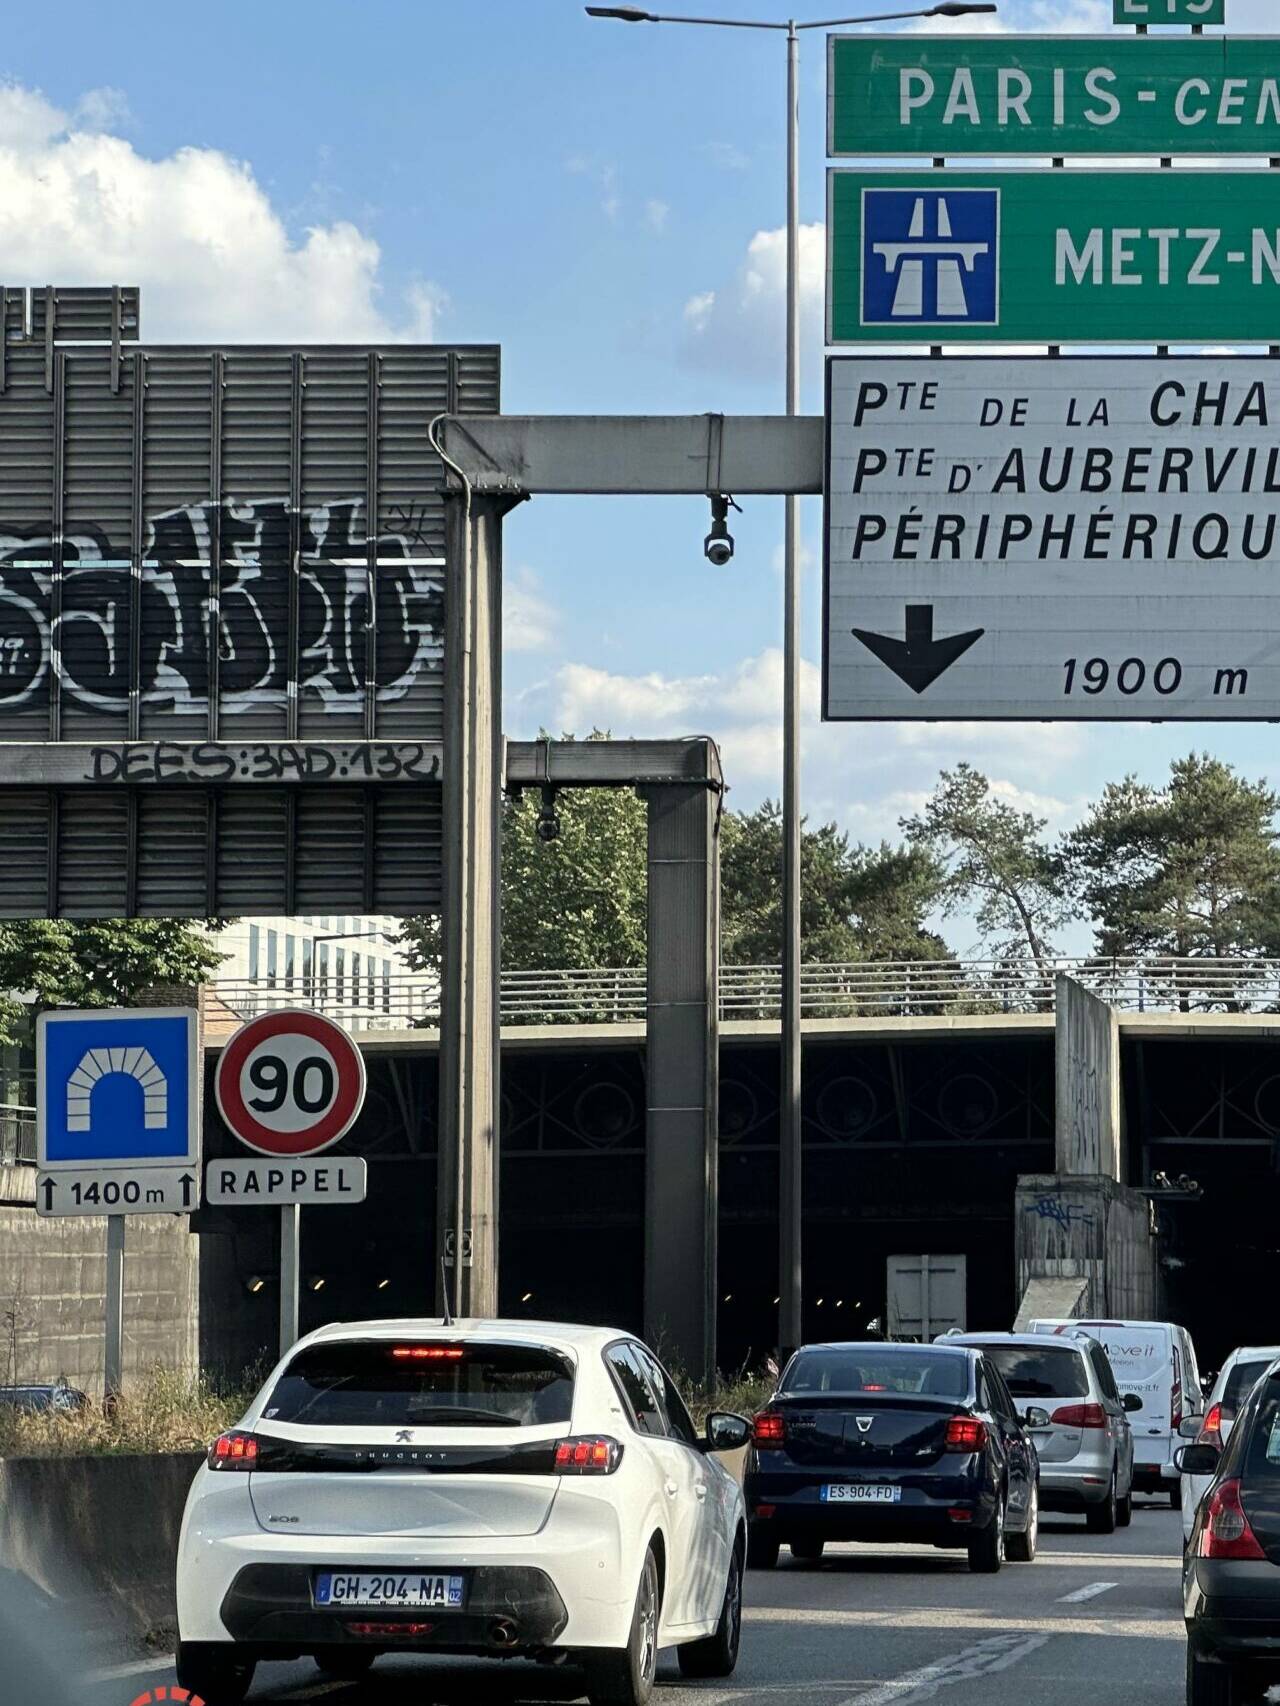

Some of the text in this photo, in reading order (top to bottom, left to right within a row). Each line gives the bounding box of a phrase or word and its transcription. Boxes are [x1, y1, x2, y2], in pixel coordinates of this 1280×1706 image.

[852, 381, 939, 427] PTE
[979, 398, 1029, 427] DE
[1065, 398, 1111, 427] LA
[852, 447, 935, 494] PTE
[1062, 657, 1249, 695] 1900 m
[247, 1055, 335, 1113] 90
[71, 1180, 165, 1206] 1400 m
[220, 1168, 352, 1194] RAPPEL
[830, 1486, 892, 1499] ES-904-FD
[333, 1577, 446, 1600] GH-204-NA
[450, 1590, 461, 1601] 02
